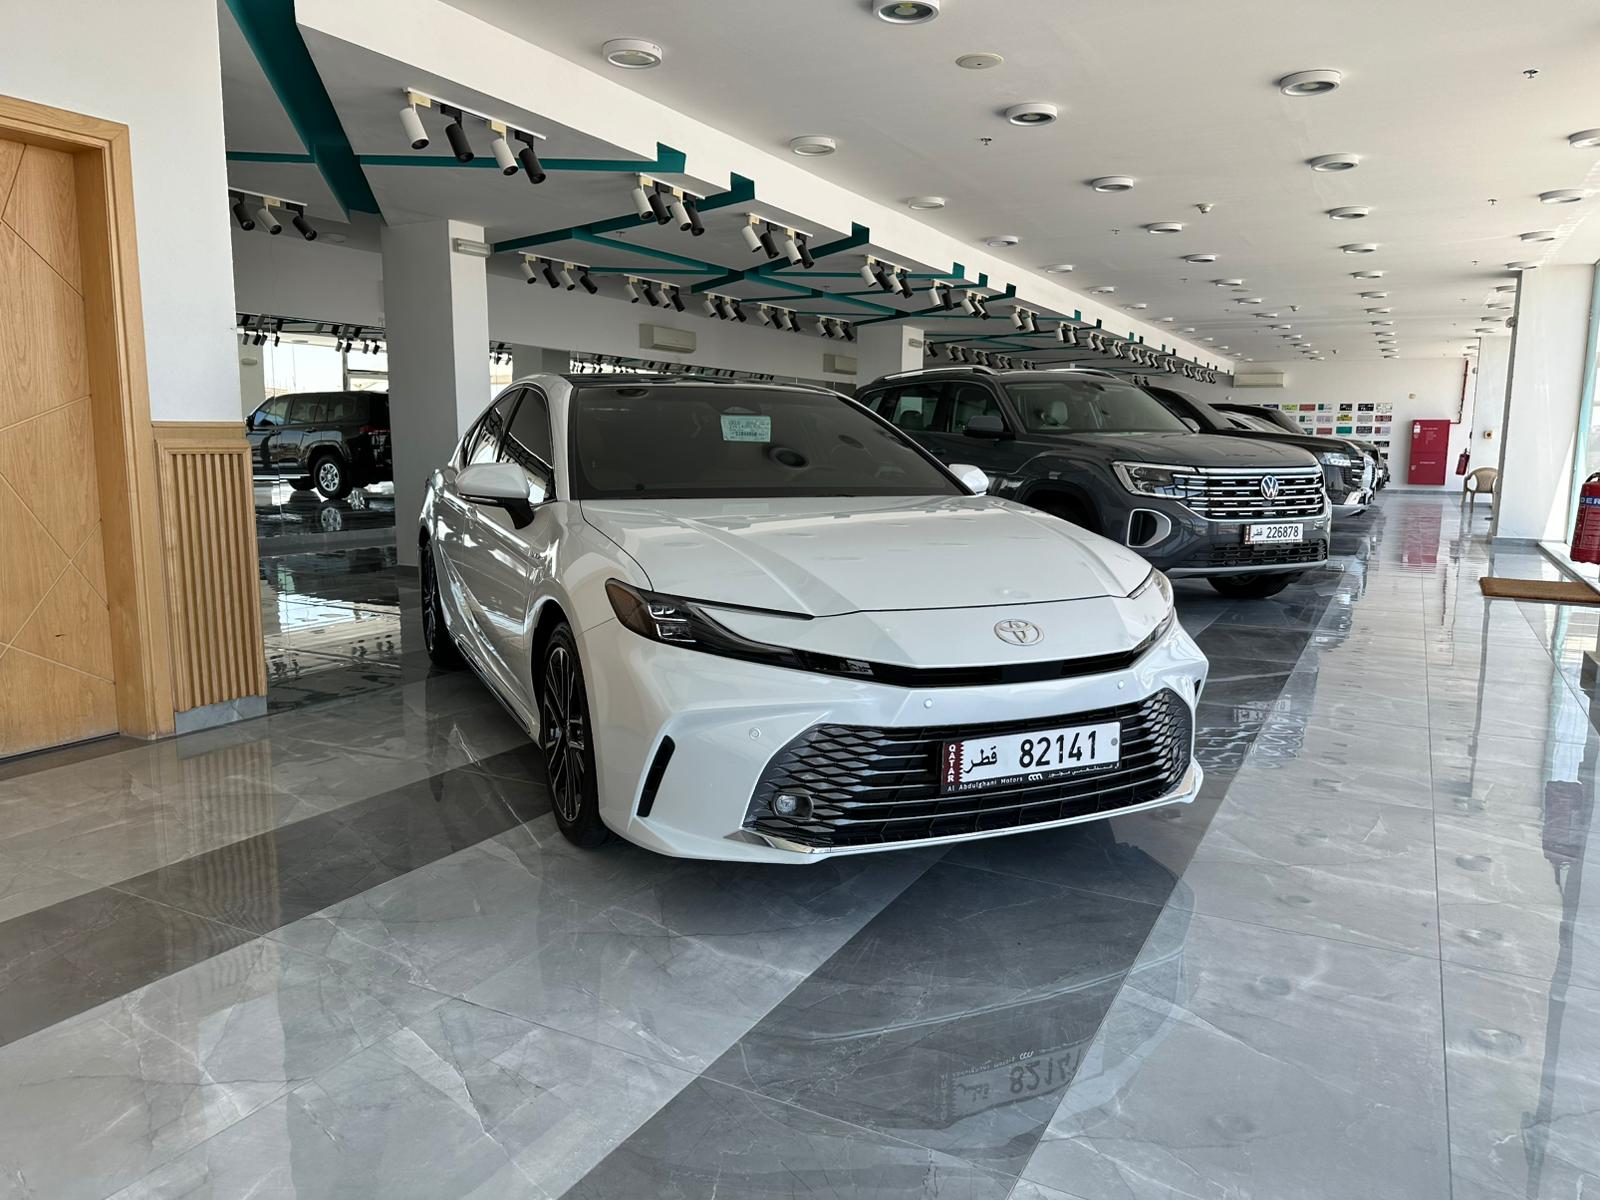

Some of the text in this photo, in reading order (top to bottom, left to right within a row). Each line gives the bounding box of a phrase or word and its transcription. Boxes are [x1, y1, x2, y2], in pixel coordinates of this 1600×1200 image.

[1266, 525, 1299, 539] 226878
[948, 744, 956, 783] QATAR
[963, 745, 998, 774] قطر
[1019, 730, 1097, 768] 82141
[958, 780, 997, 790] Abdulghani
[1000, 776, 1023, 784] Motors
